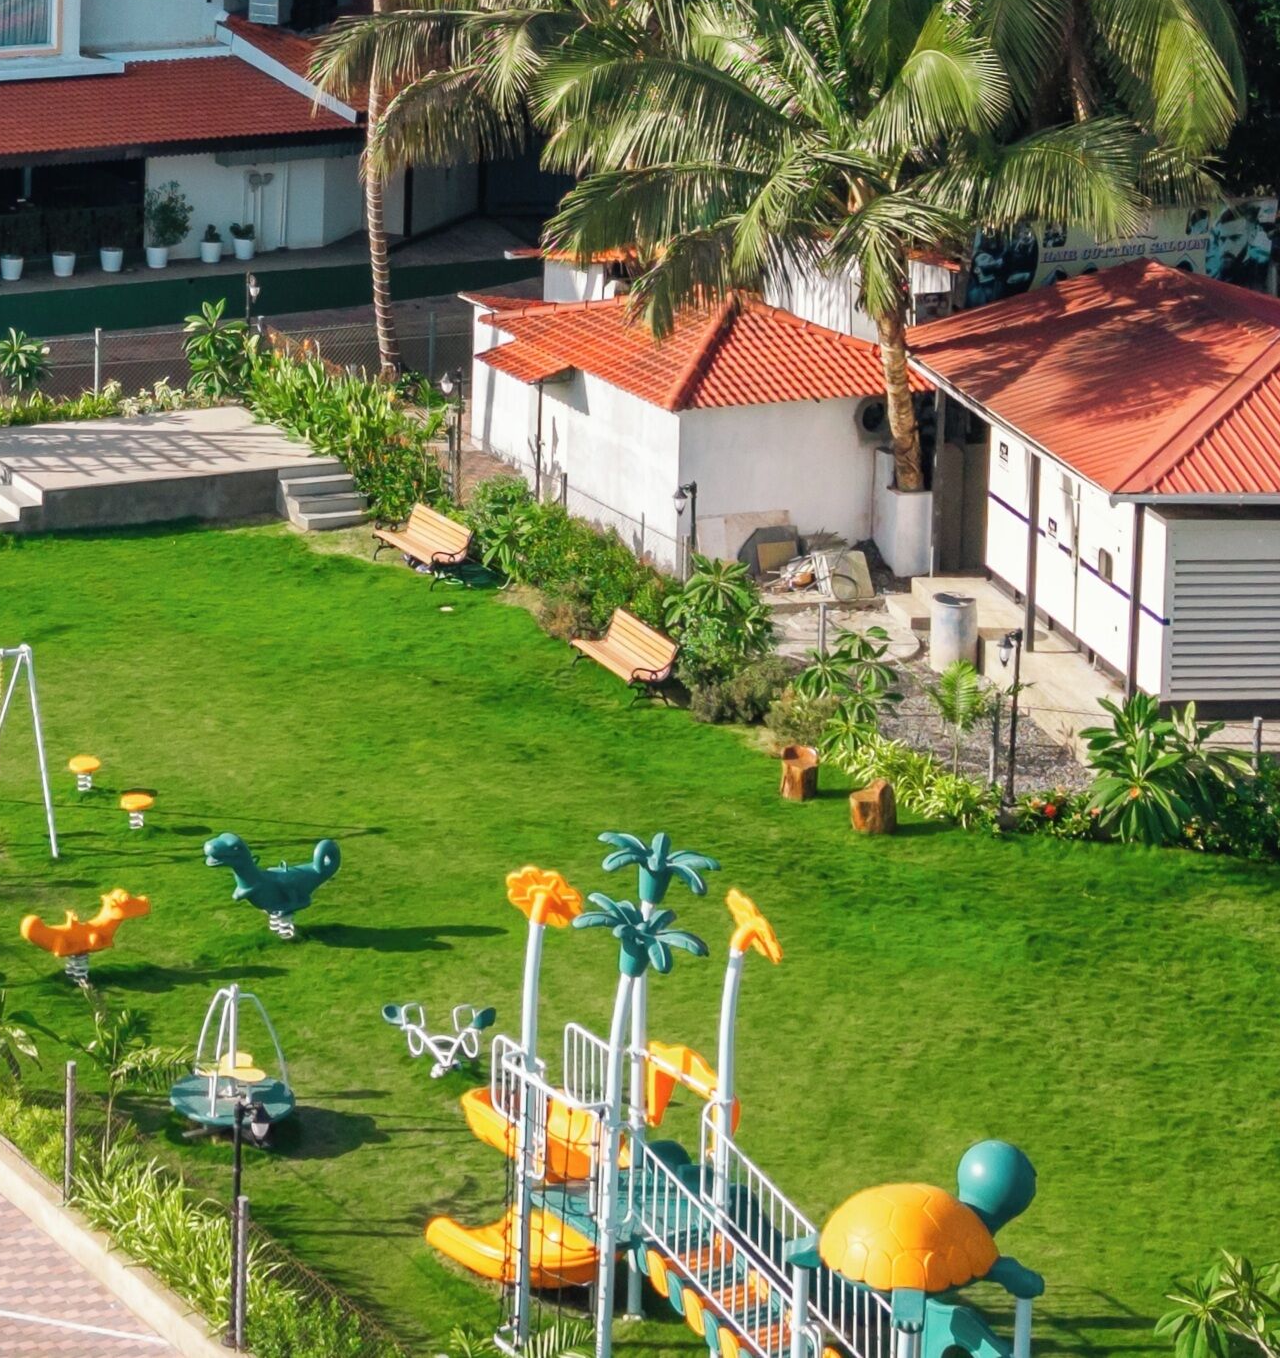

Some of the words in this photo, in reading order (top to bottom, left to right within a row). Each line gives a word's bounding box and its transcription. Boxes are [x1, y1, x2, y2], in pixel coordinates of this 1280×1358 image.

[1041, 249, 1078, 263] HAIR
[1080, 243, 1146, 260] CUTTING
[1149, 238, 1210, 254] SALOON
